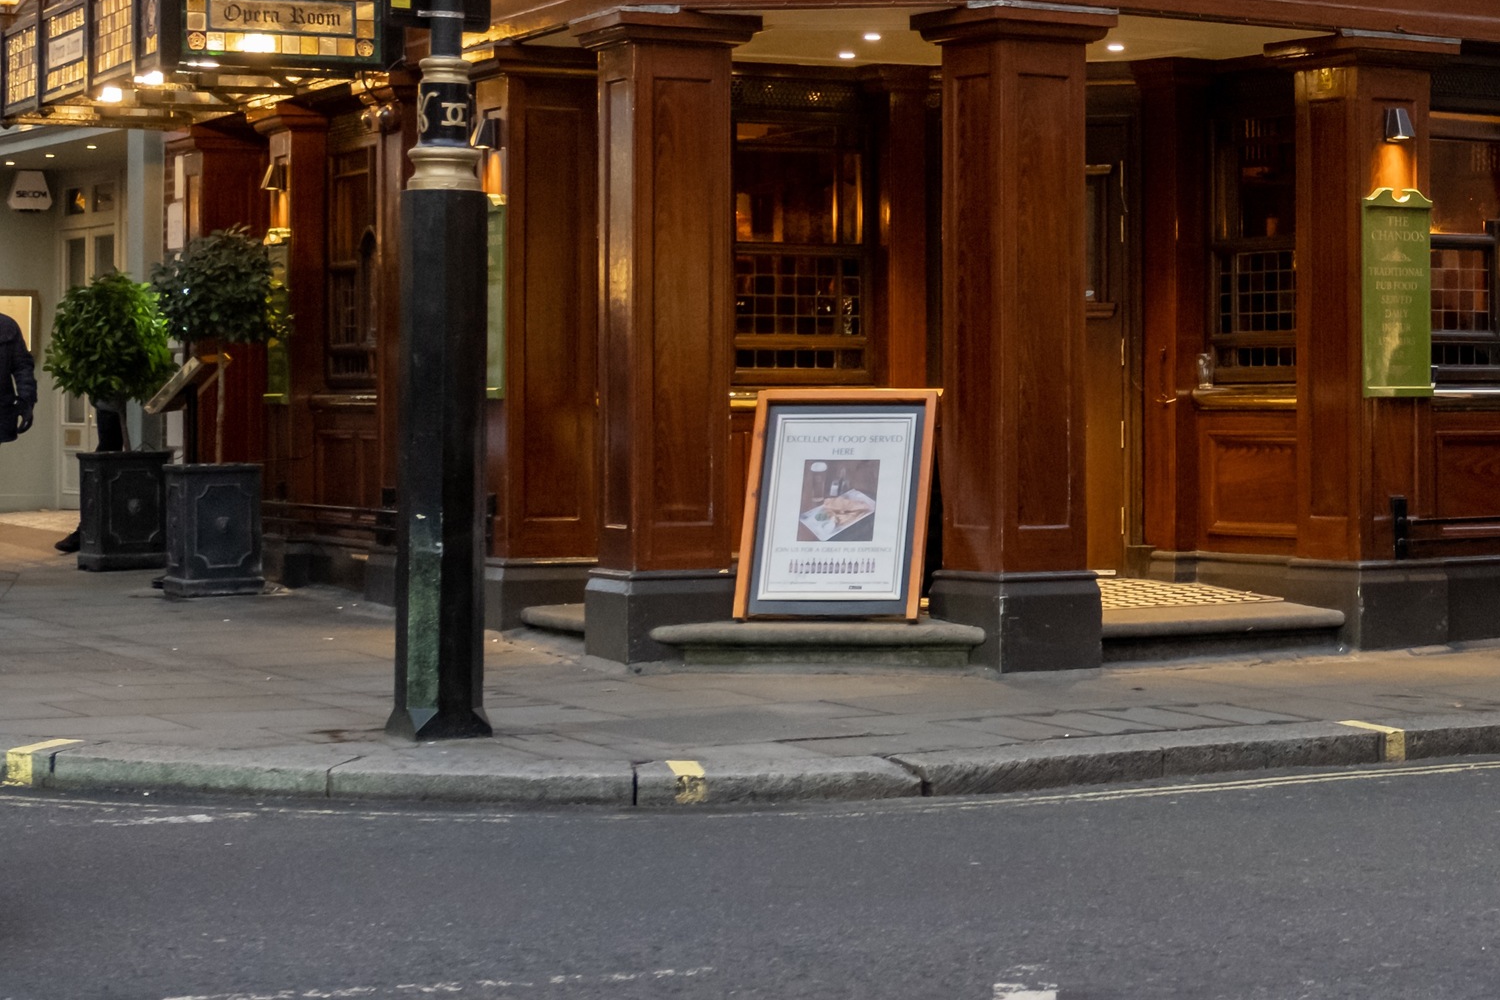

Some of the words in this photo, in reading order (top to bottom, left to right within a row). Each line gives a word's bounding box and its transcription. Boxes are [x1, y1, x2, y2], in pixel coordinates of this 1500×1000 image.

[223, 3, 279, 24] Opera
[290, 6, 341, 26] Room
[15, 190, 48, 199] SECOM
[1387, 215, 1410, 227] THE
[1371, 230, 1425, 242] CHANDOS
[1368, 266, 1425, 277] TRADITIONAL
[1375, 281, 1392, 290] PUB
[1393, 281, 1418, 291] FOOD
[786, 434, 835, 443] EXCELLENT
[838, 434, 866, 443] FOOD
[869, 434, 904, 443] SERVED
[832, 447, 855, 456] HERE
